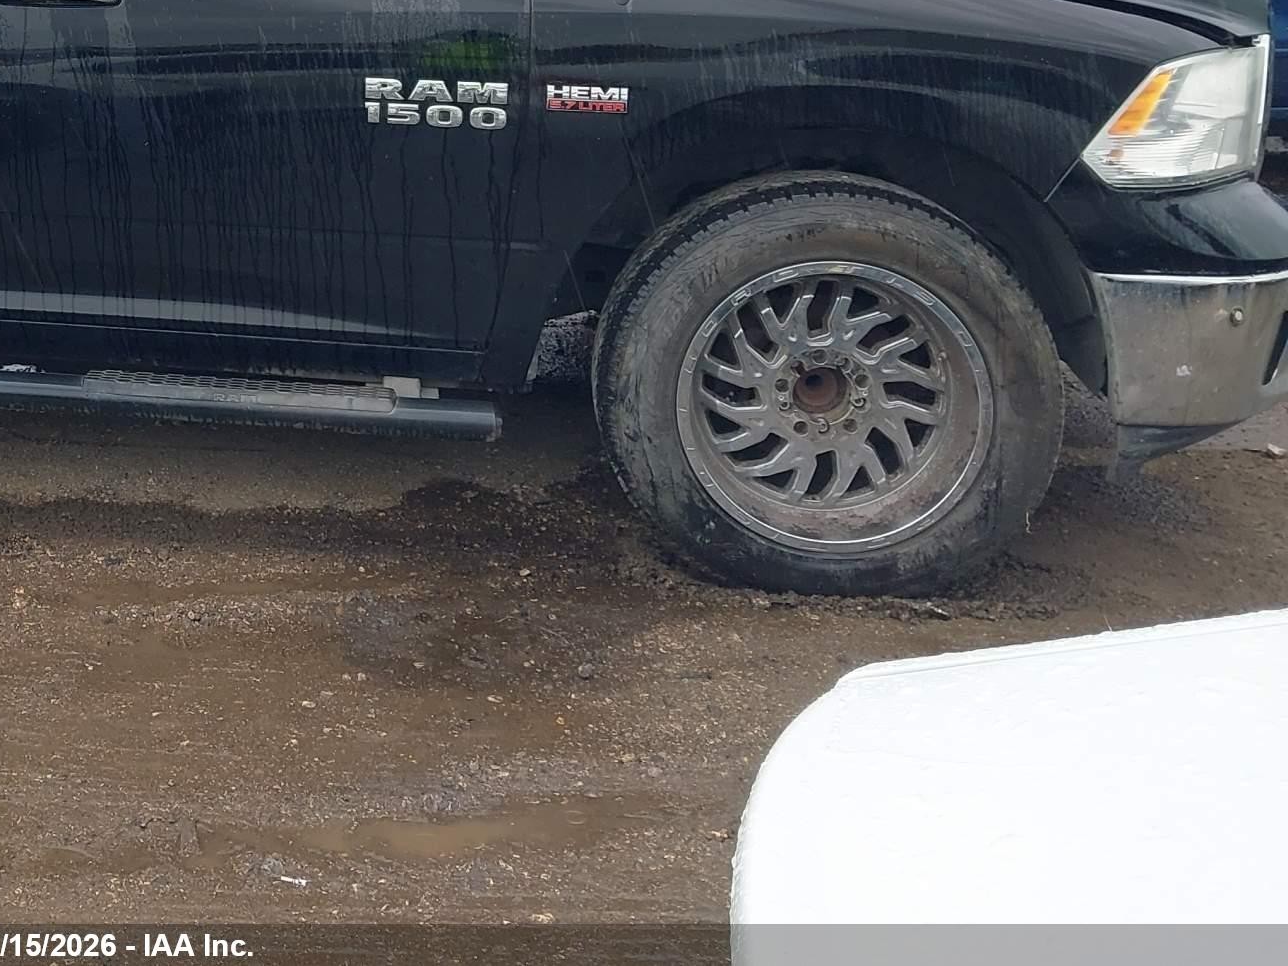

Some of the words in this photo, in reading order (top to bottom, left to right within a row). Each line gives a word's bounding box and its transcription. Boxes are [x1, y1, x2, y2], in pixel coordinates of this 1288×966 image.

[364, 77, 509, 105] RAM
[546, 84, 629, 101] HEMI
[364, 101, 508, 131] 1500
[549, 99, 577, 111] 5.7
[578, 100, 626, 113] LITER
